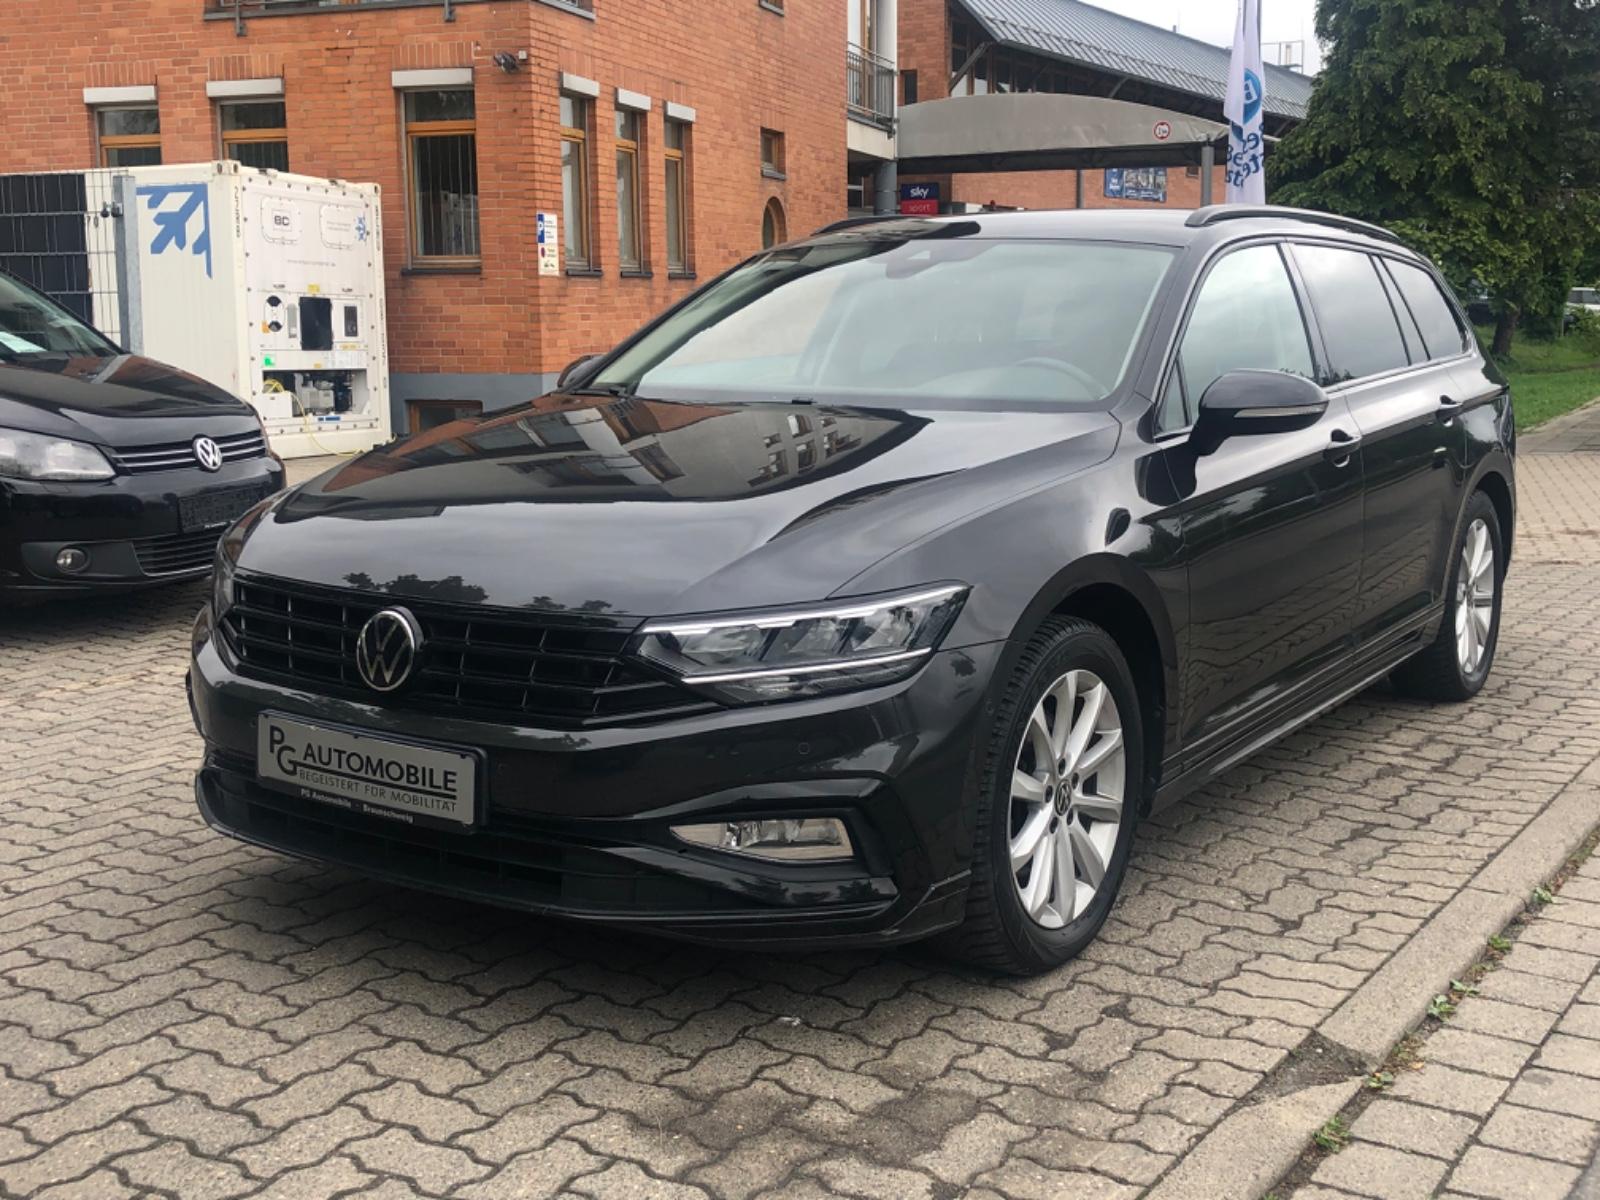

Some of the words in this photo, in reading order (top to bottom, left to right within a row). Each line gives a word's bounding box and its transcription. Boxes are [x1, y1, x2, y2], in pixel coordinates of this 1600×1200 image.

[910, 186, 929, 199] sky
[357, 610, 414, 691] VW
[299, 770, 360, 791] BEGEISTERT
[303, 743, 457, 790] AUTOMOBILE
